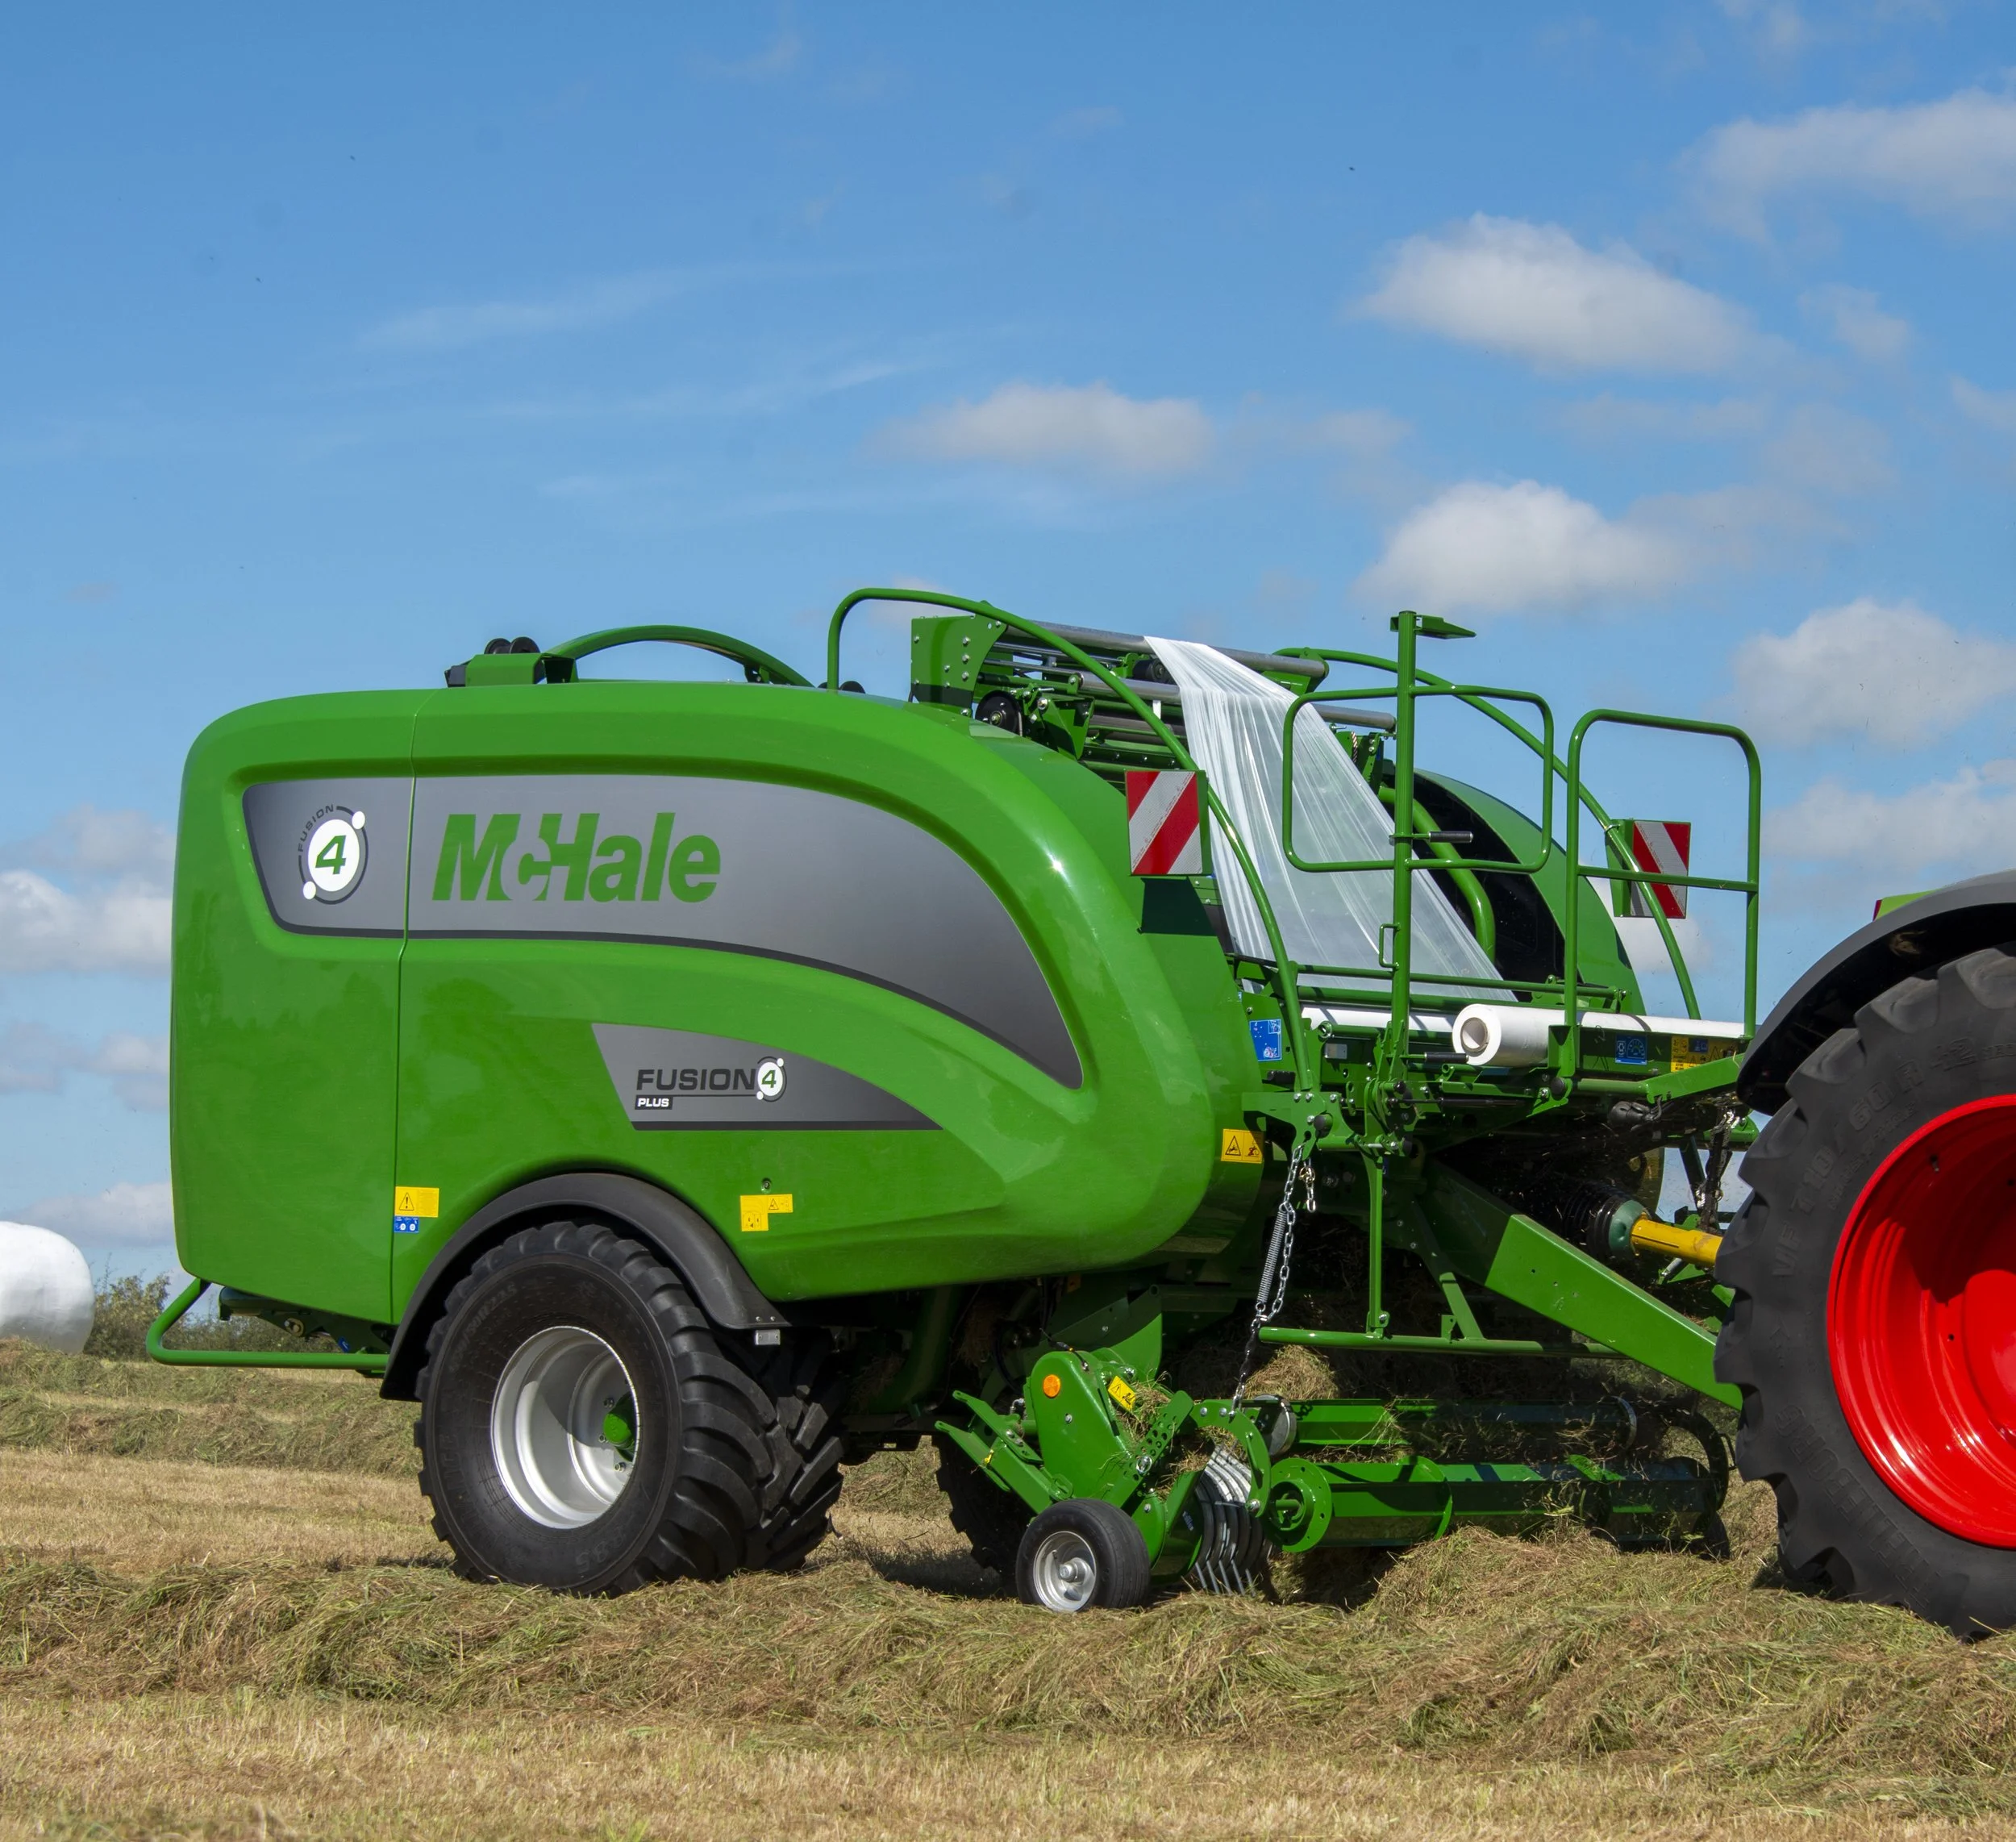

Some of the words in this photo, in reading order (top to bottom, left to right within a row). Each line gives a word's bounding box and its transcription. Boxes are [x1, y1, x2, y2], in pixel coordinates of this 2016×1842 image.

[298, 803, 335, 852] FUSION
[314, 835, 347, 875] 4
[432, 812, 721, 902] McHale
[635, 1068, 757, 1091] FUSION
[760, 1069, 777, 1089] 4
[636, 1097, 670, 1108] PLUS
[1773, 1404, 1943, 1612] TRELLEBORG
